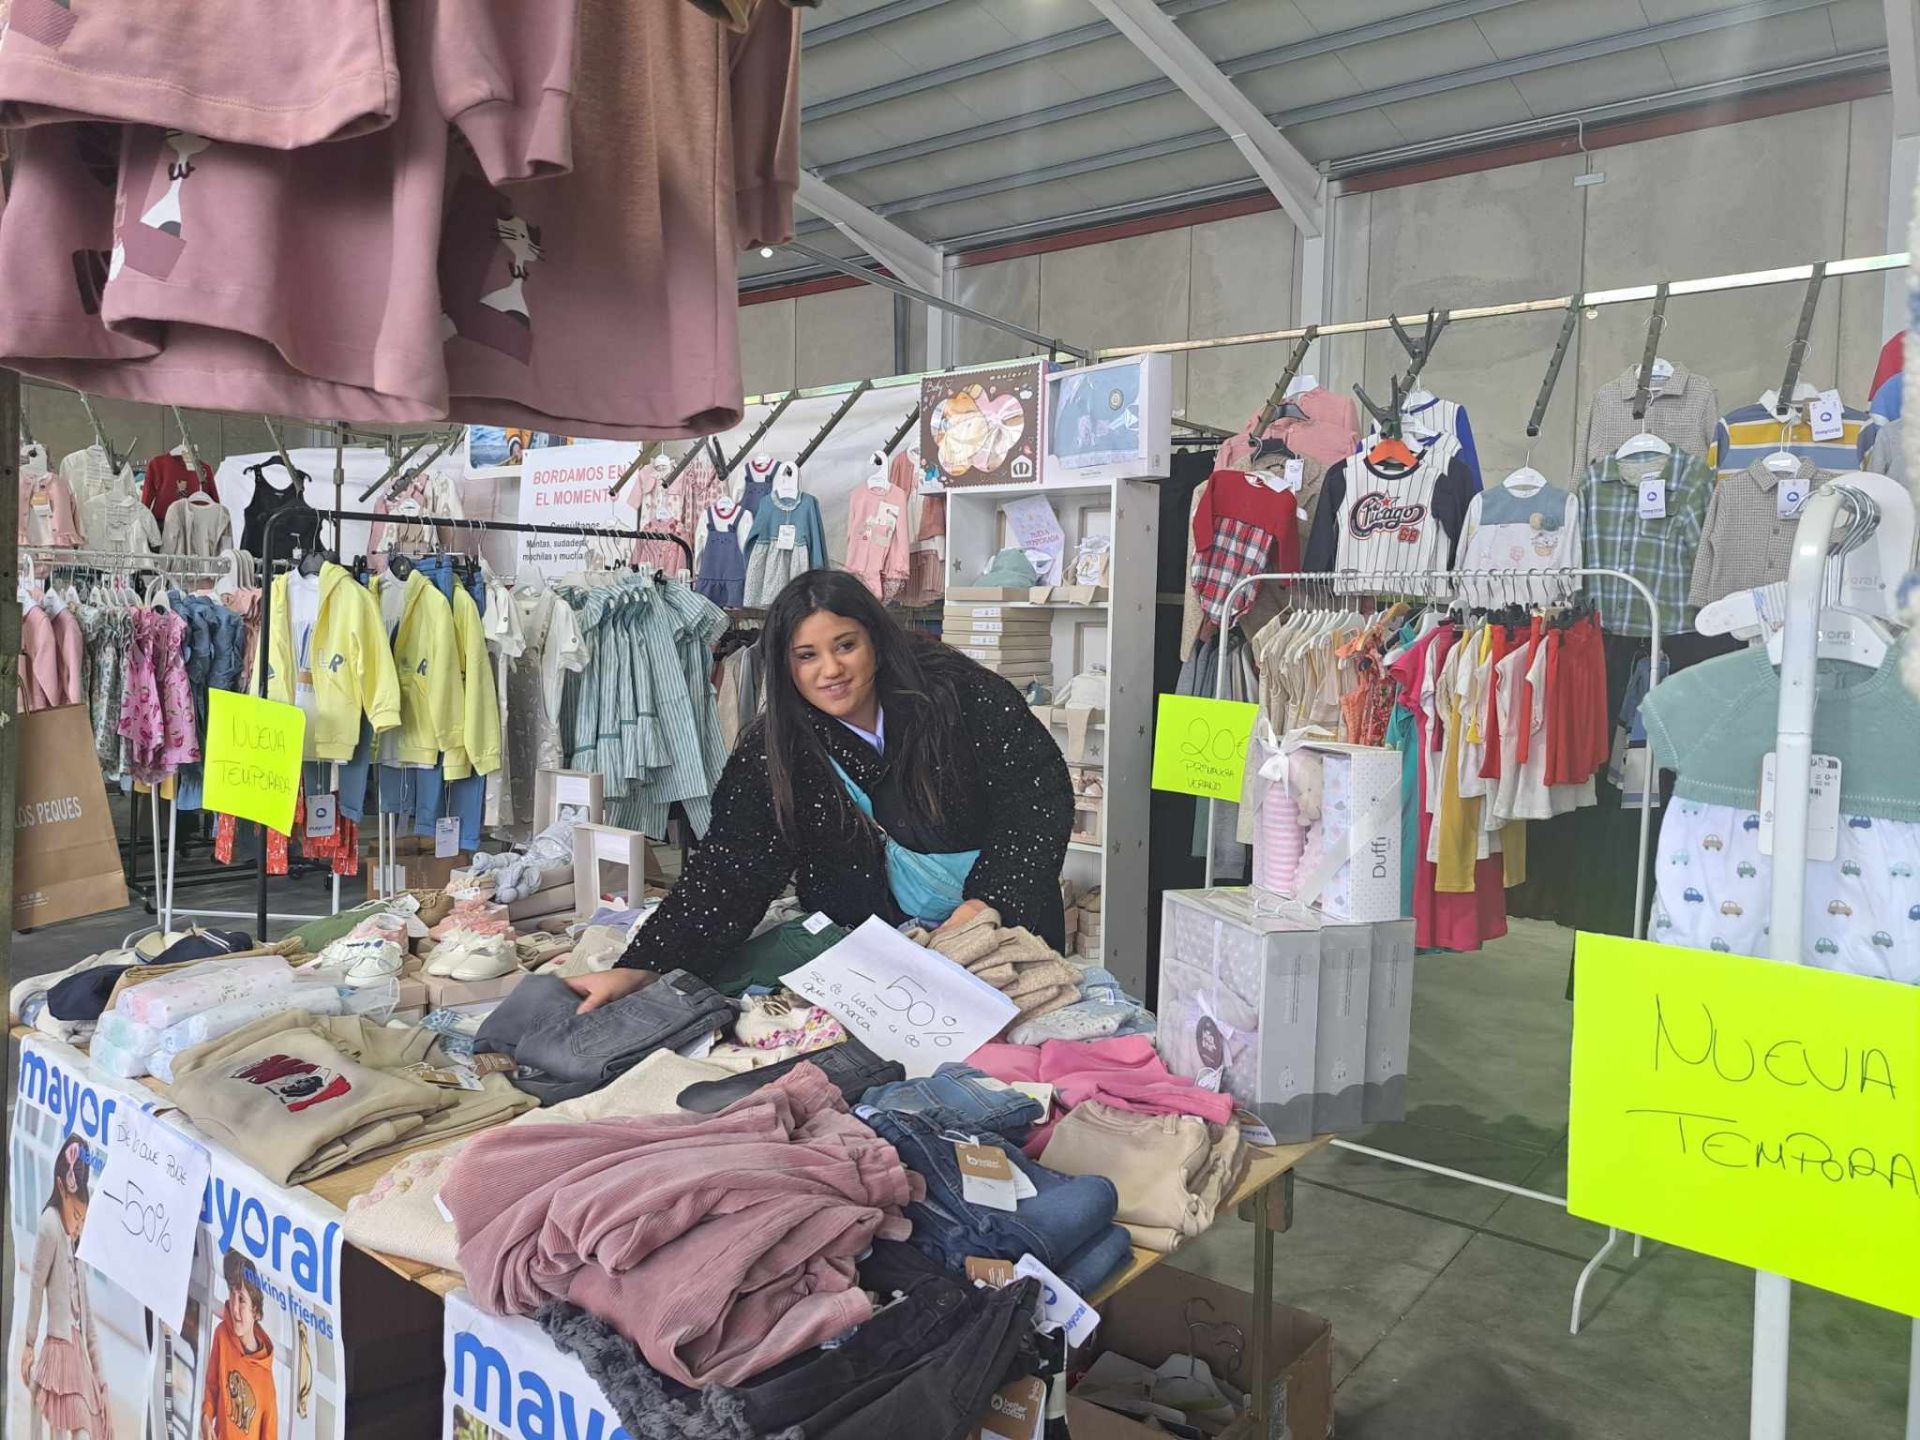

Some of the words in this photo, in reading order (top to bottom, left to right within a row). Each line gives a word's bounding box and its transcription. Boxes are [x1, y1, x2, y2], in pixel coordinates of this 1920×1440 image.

[533, 466, 604, 485] BORDAMOS
[608, 465, 627, 480] EN
[536, 492, 550, 506] EL
[232, 714, 287, 754] NUEVA
[36, 796, 82, 824] PEQUES
[1371, 836, 1387, 879] Duffi
[834, 1000, 871, 1032] marca
[848, 968, 965, 1047] -50%
[1655, 993, 1896, 1101] NUEVA
[20, 1050, 117, 1146] mayor
[1626, 1109, 1920, 1200] TEMPORA
[102, 1179, 173, 1253] -50%
[244, 1268, 287, 1312] making
[287, 1285, 334, 1340] friends
[454, 1331, 638, 1440] may
[1003, 1397, 1028, 1413] better
[1001, 1406, 1027, 1421] cotton
